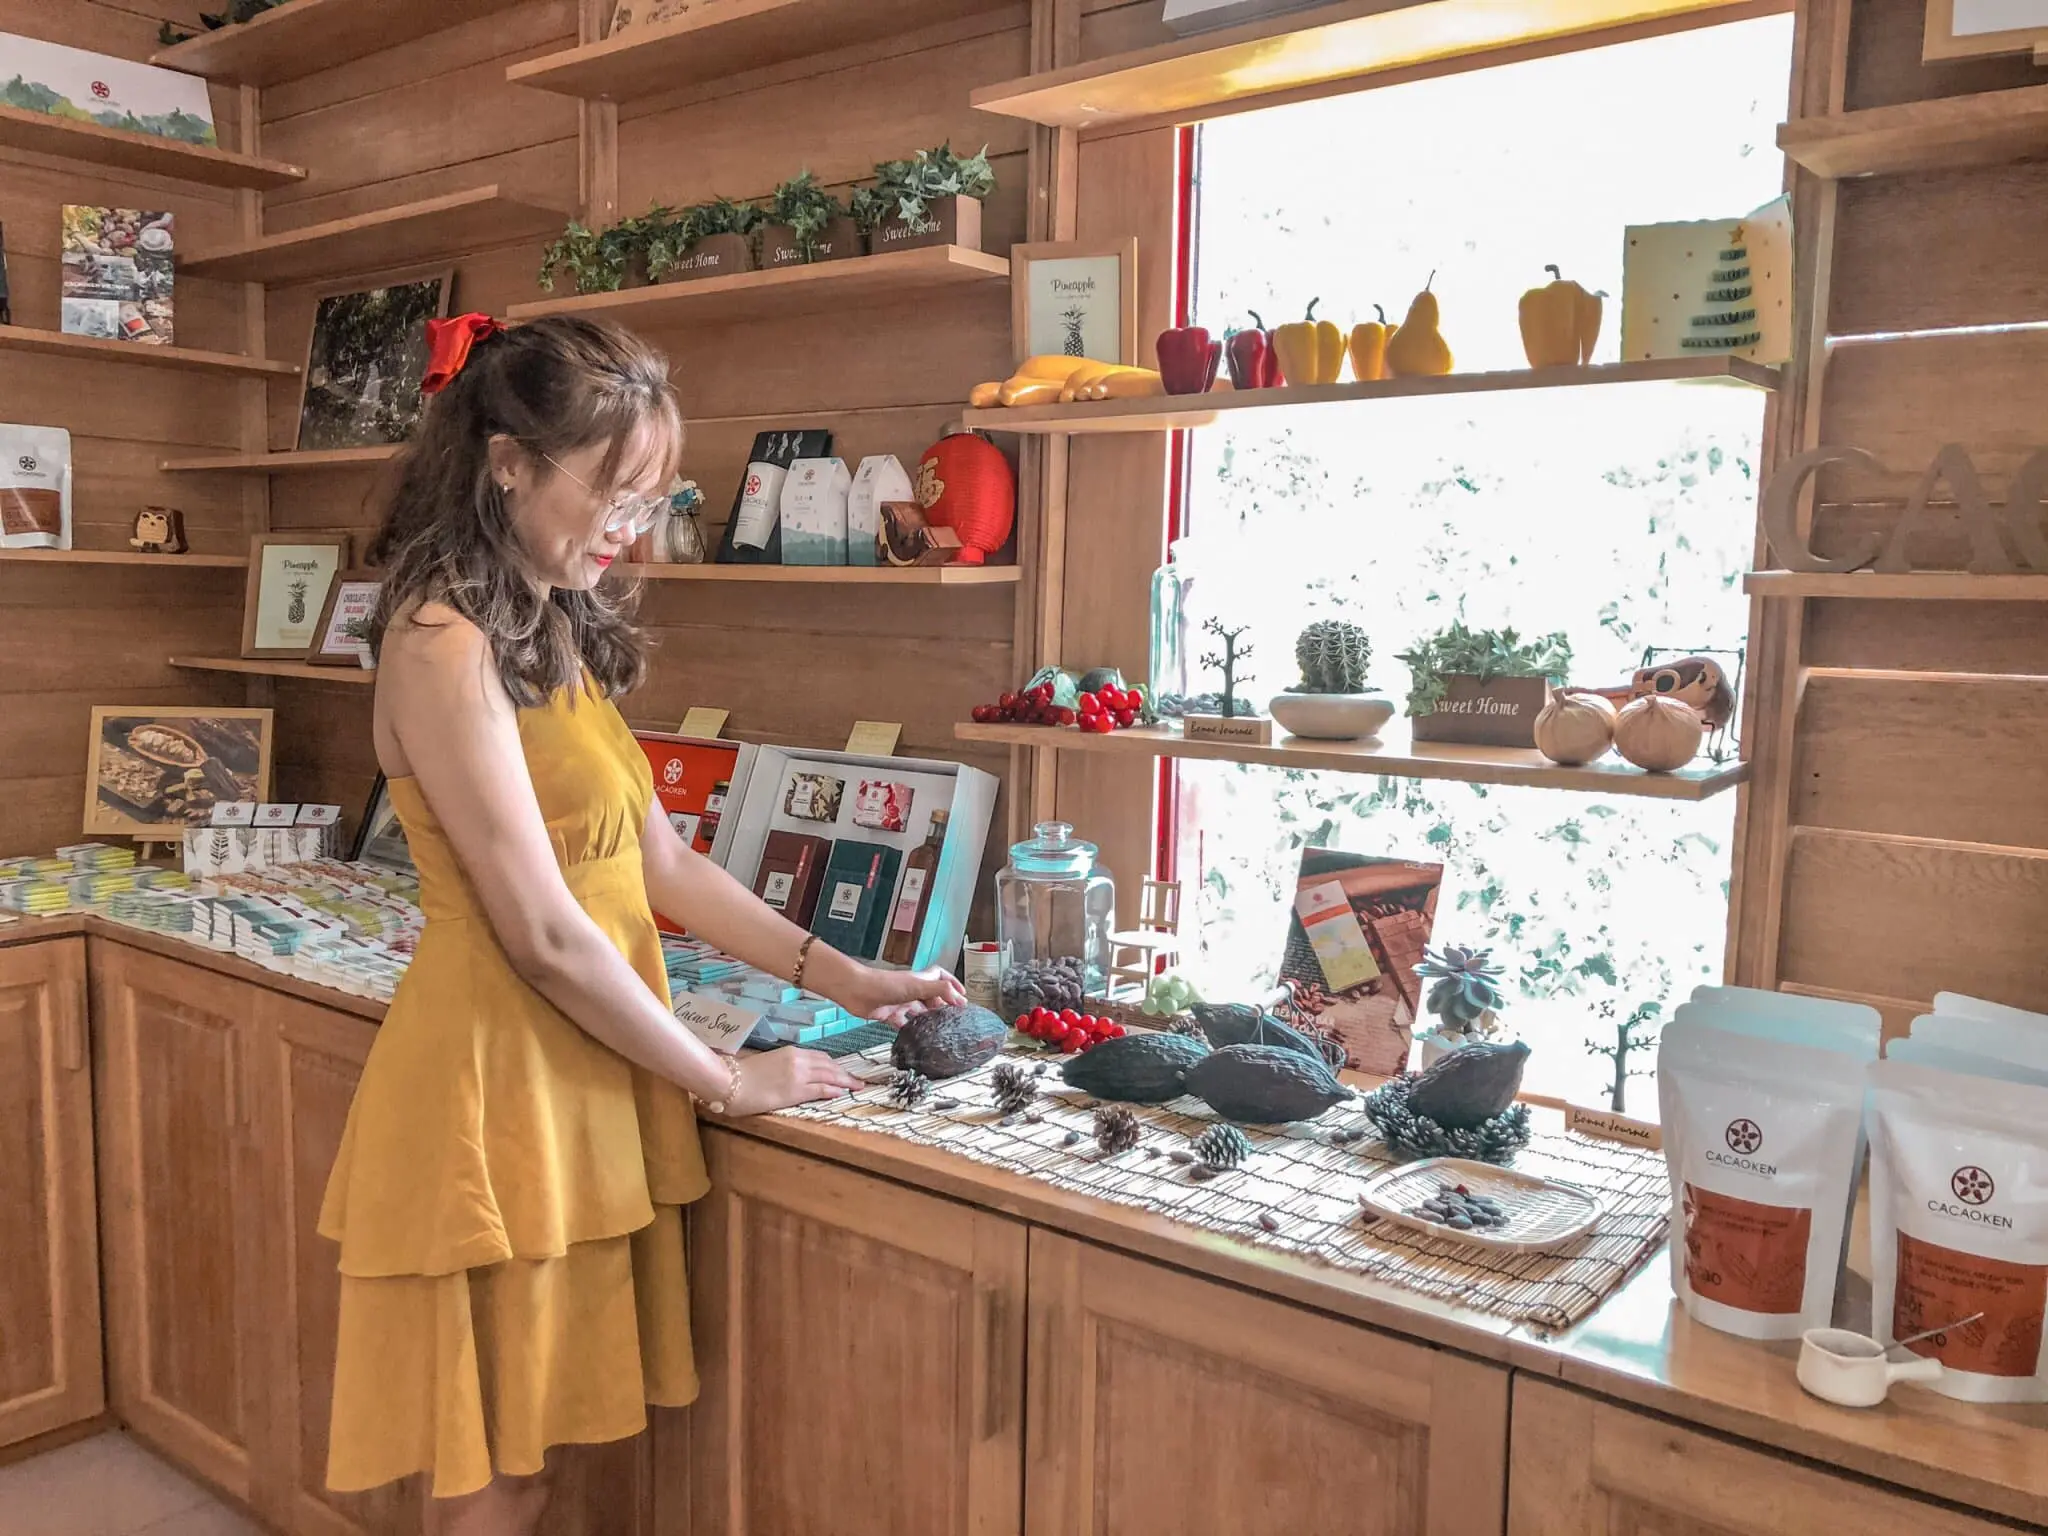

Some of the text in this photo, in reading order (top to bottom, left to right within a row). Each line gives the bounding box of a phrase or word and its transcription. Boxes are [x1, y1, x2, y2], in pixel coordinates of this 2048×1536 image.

[694, 252, 720, 268] Home
[1050, 276, 1096, 293] Pineapple
[281, 559, 319, 571] Pineapple
[1475, 696, 1520, 716] Home
[674, 1001, 741, 1039] Cacao Soap
[1573, 1110, 1606, 1128] Bonne
[1705, 1150, 1777, 1176] CACAOKEN
[1927, 1200, 2013, 1229] CACAOKEN
